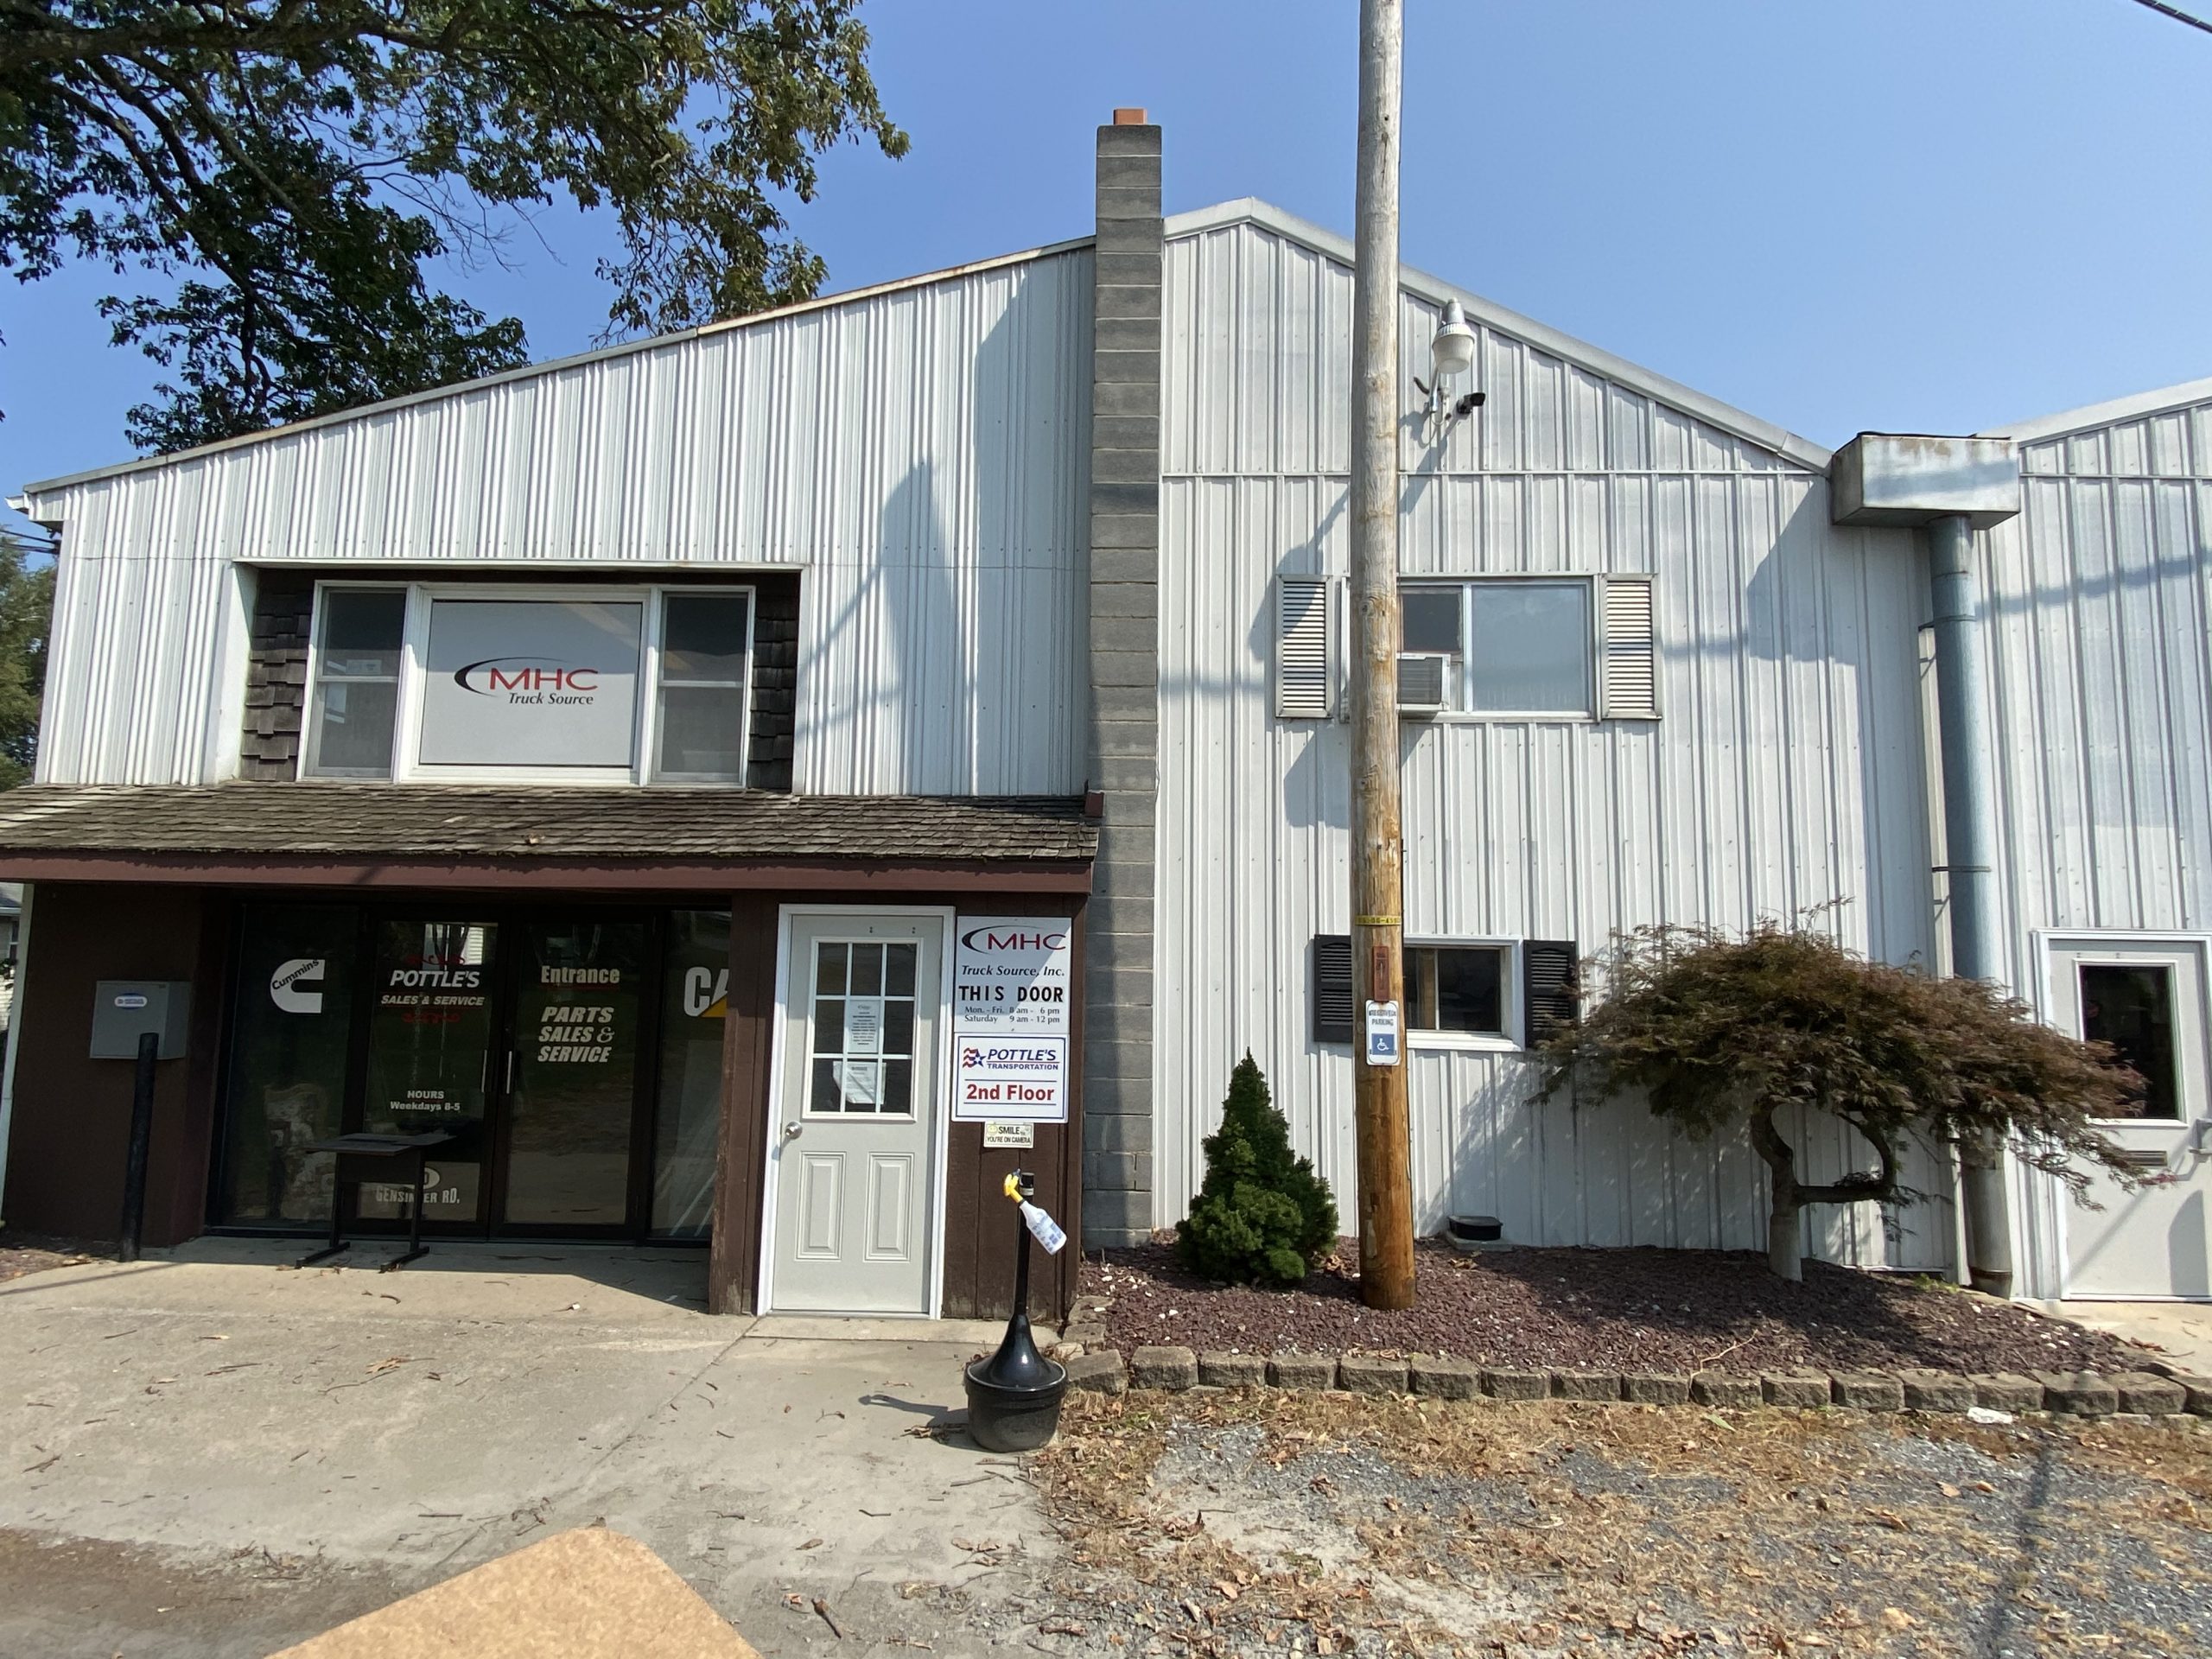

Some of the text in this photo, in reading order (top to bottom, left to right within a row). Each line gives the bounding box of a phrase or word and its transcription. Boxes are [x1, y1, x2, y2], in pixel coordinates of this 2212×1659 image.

[489, 667, 599, 691] MHC
[508, 692, 594, 705] Truck Source
[988, 932, 1066, 950] MHC
[271, 958, 320, 990] Cummins
[389, 969, 480, 988] POTTLE'S
[540, 965, 620, 983] Entrance
[962, 964, 1065, 978] Truck Source, Inc.
[381, 995, 485, 1006] SALES & SERVICE
[958, 985, 1064, 1002] THIS DOOR
[540, 1006, 614, 1023] PARTS
[964, 1014, 998, 1024] Saturday
[538, 1026, 615, 1043] SALES &
[537, 1046, 612, 1063] SERVICE
[988, 1048, 1056, 1061] POTTLE'S
[407, 1090, 444, 1099] HOURS
[966, 1084, 1055, 1101] 2nd Floor
[390, 1101, 461, 1112] Weekdays 8-5
[998, 1126, 1020, 1135] SMILE
[376, 1185, 461, 1204] GENSINER RD.
